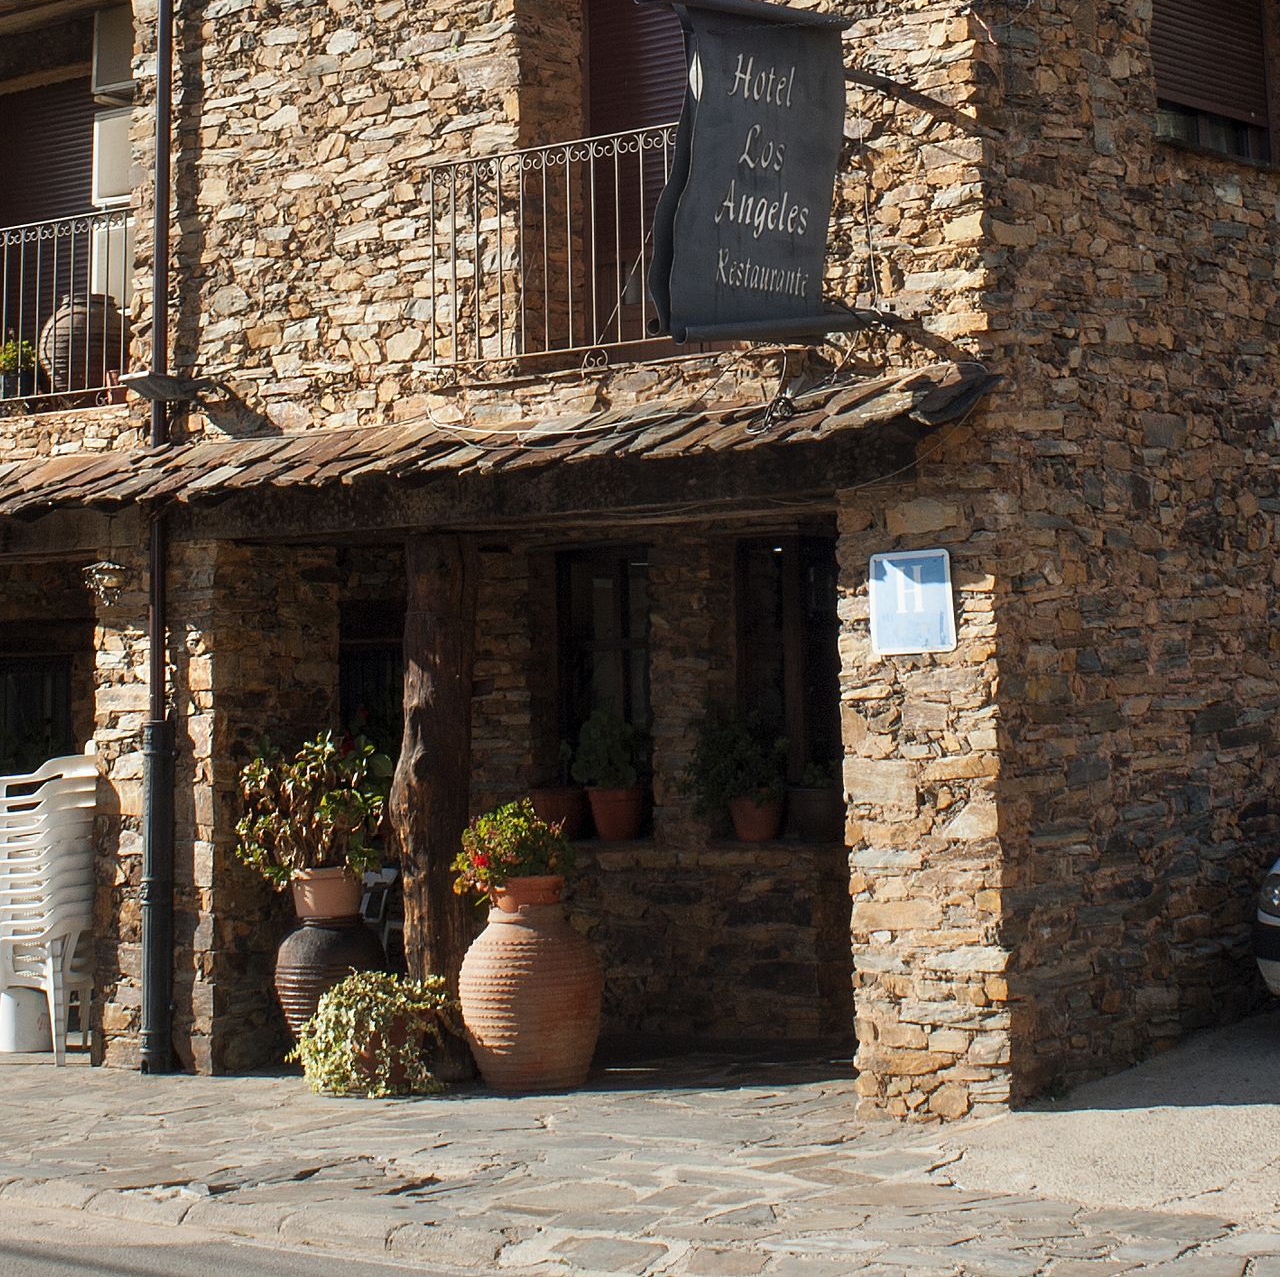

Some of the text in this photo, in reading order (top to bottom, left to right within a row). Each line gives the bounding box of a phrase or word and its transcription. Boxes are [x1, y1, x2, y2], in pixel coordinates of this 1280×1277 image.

[728, 53, 796, 108] Hotel
[738, 124, 785, 172] Los
[714, 180, 809, 240] Angeles
[715, 248, 809, 298] Restaurante
[896, 565, 925, 613] H
